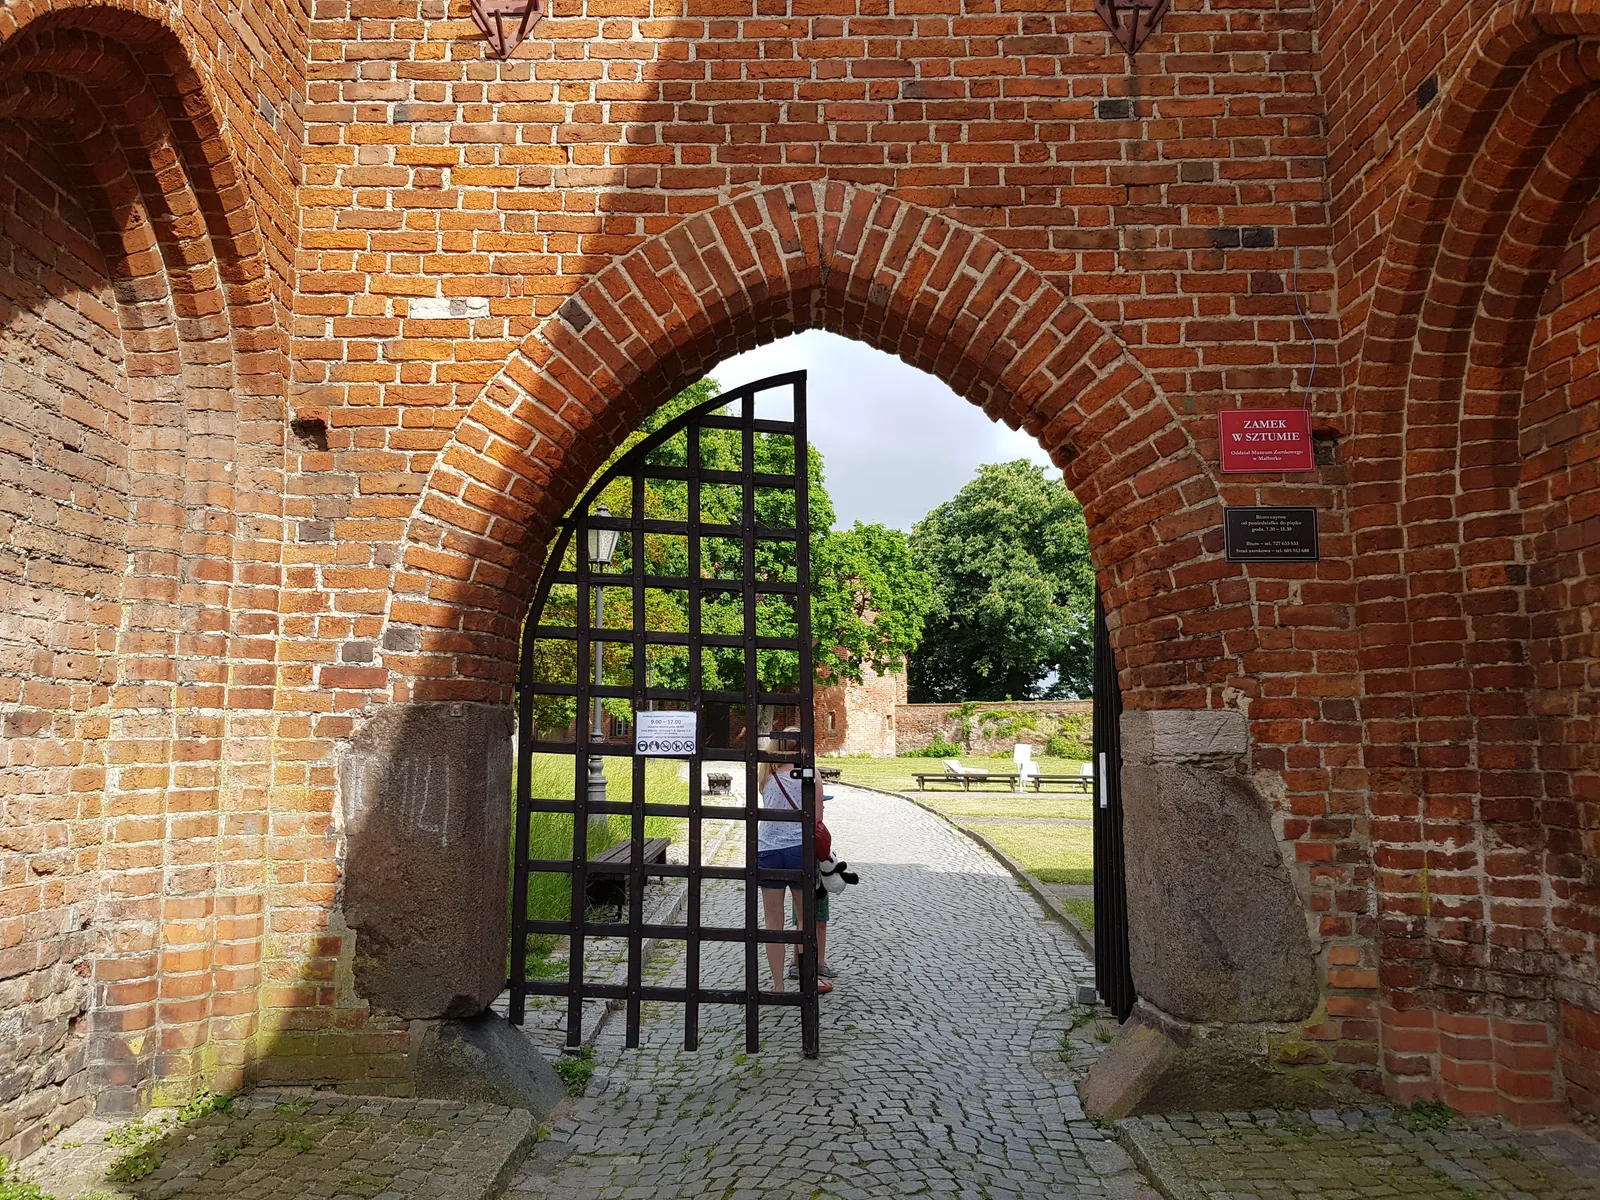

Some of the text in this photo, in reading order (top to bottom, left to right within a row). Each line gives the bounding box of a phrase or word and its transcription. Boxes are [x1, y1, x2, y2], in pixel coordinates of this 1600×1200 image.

[1243, 419, 1287, 429] ZAMEK
[1232, 432, 1300, 442] W SZTUMIE
